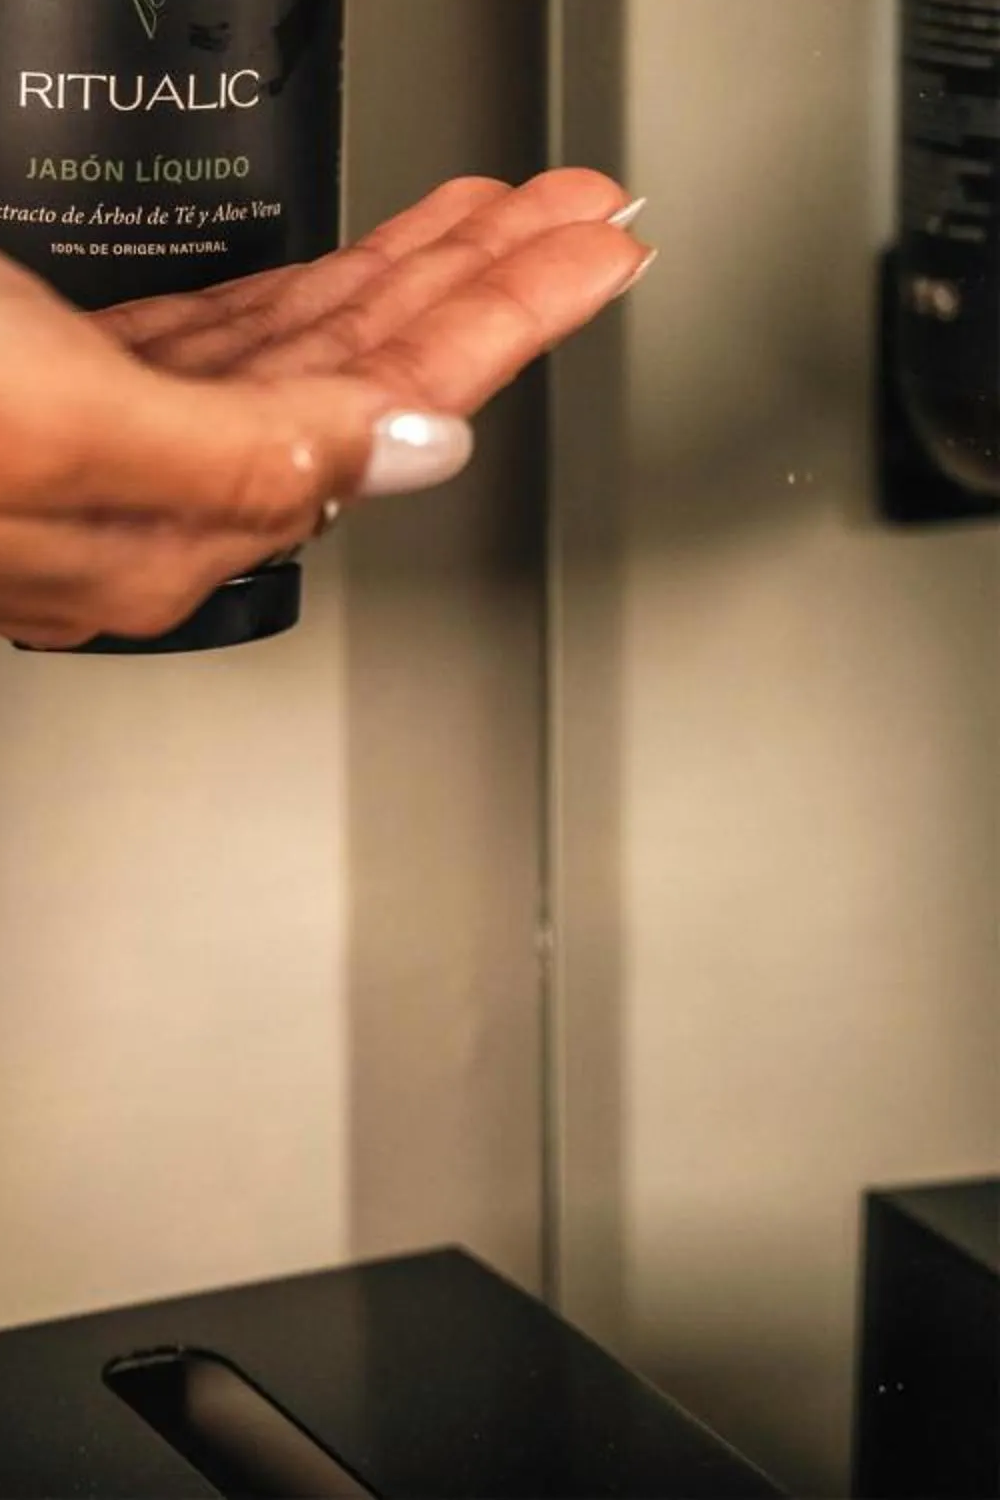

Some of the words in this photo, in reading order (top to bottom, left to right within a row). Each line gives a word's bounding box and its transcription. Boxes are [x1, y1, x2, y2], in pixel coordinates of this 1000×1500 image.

[18, 69, 260, 111] RITUALIC
[25, 155, 124, 182] JABÓN
[135, 154, 251, 183] LÍQUIDO
[61, 204, 85, 225] de
[88, 203, 143, 226] Árbol
[147, 204, 169, 226] de
[173, 202, 196, 226] Té
[196, 210, 209, 229] y
[212, 203, 250, 222] Aloe
[250, 200, 282, 218] Vera
[50, 243, 86, 255] 100%
[89, 243, 109, 255] DE
[113, 243, 166, 256] ORIGEN
[169, 241, 229, 255] NATURAL
